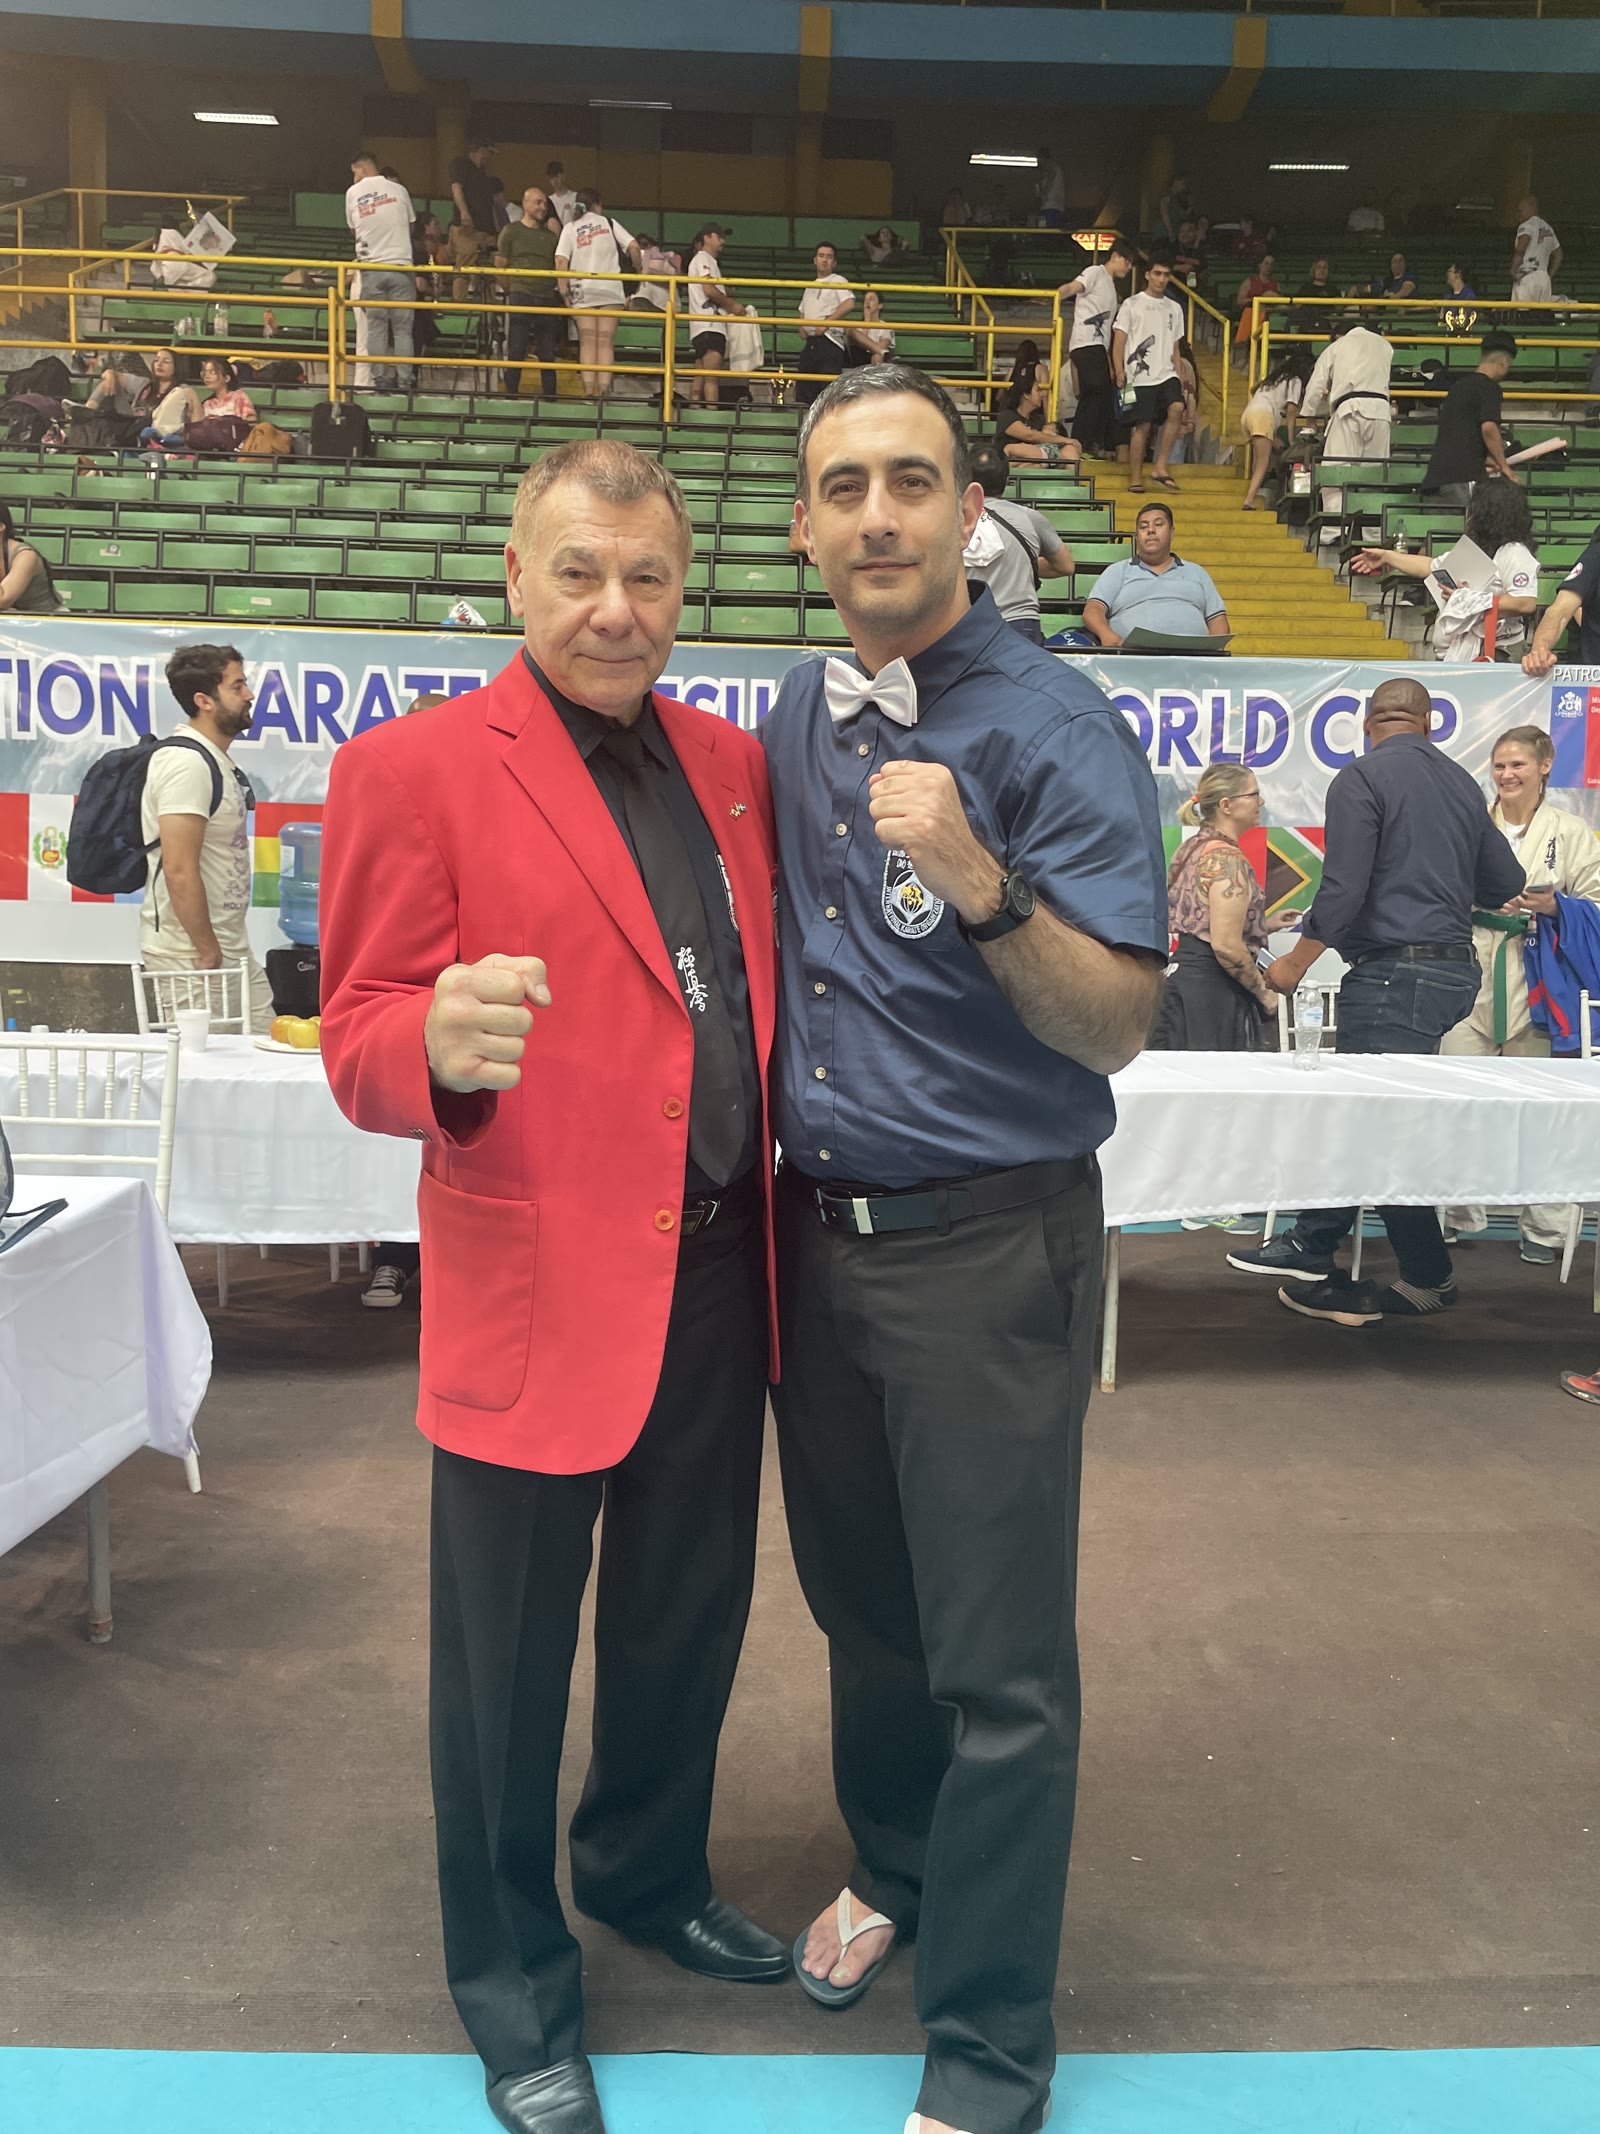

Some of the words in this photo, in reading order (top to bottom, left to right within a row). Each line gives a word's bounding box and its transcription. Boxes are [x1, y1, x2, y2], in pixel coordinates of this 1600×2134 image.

[0, 658, 151, 736] ION
[234, 669, 482, 744] ARA
[1108, 694, 1290, 768] ORLD
[1310, 695, 1458, 770] CP
